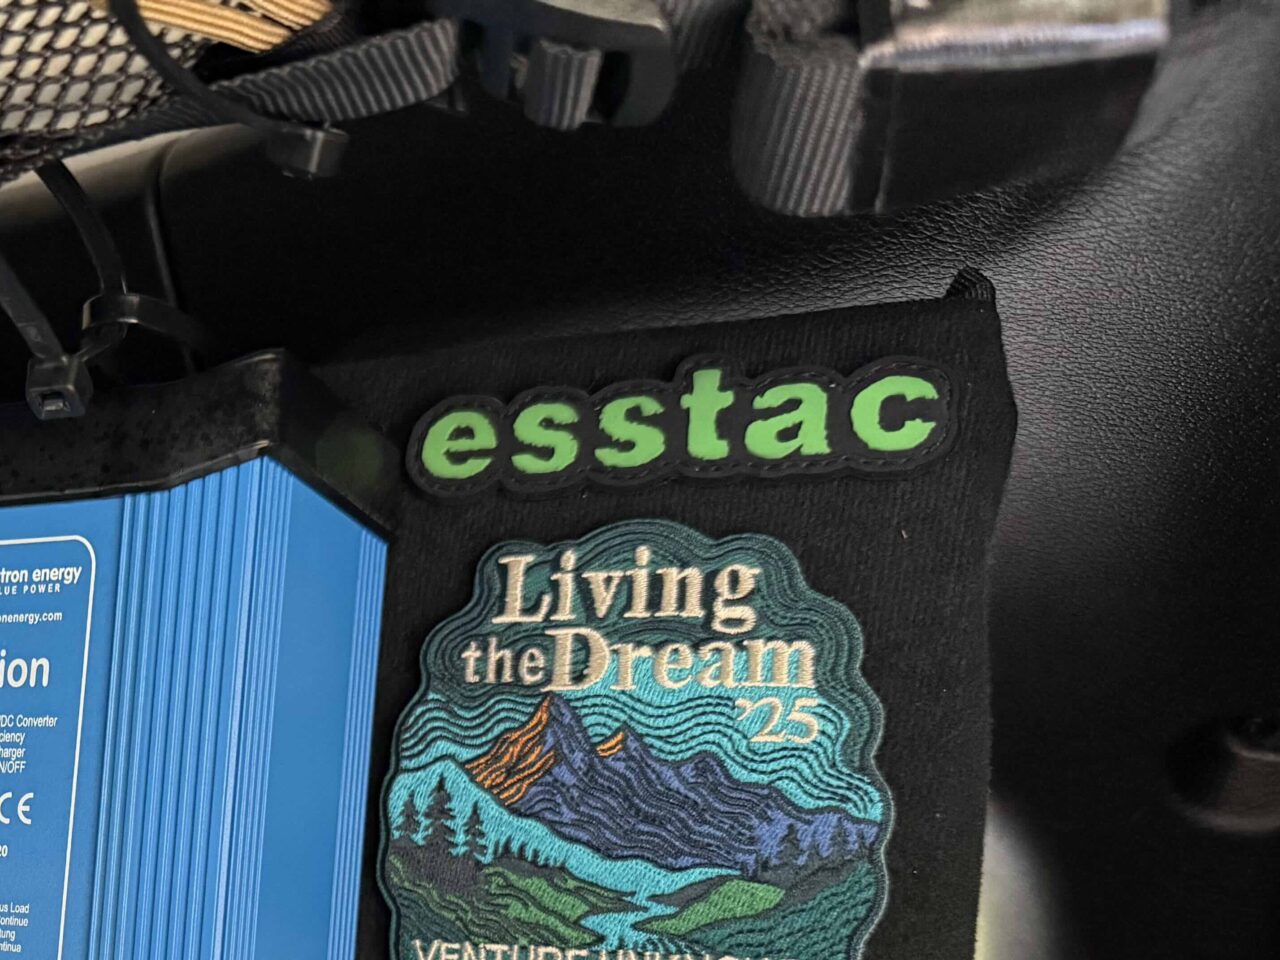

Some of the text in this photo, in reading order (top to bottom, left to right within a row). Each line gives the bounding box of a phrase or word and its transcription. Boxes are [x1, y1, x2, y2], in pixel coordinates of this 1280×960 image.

[421, 368, 938, 479] esstac
[32, 566, 82, 584] energy
[23, 583, 61, 594] POWER
[492, 544, 760, 635] Living
[461, 627, 816, 692] the Dream
[16, 714, 57, 728] Converter
[10, 902, 30, 914] Load
